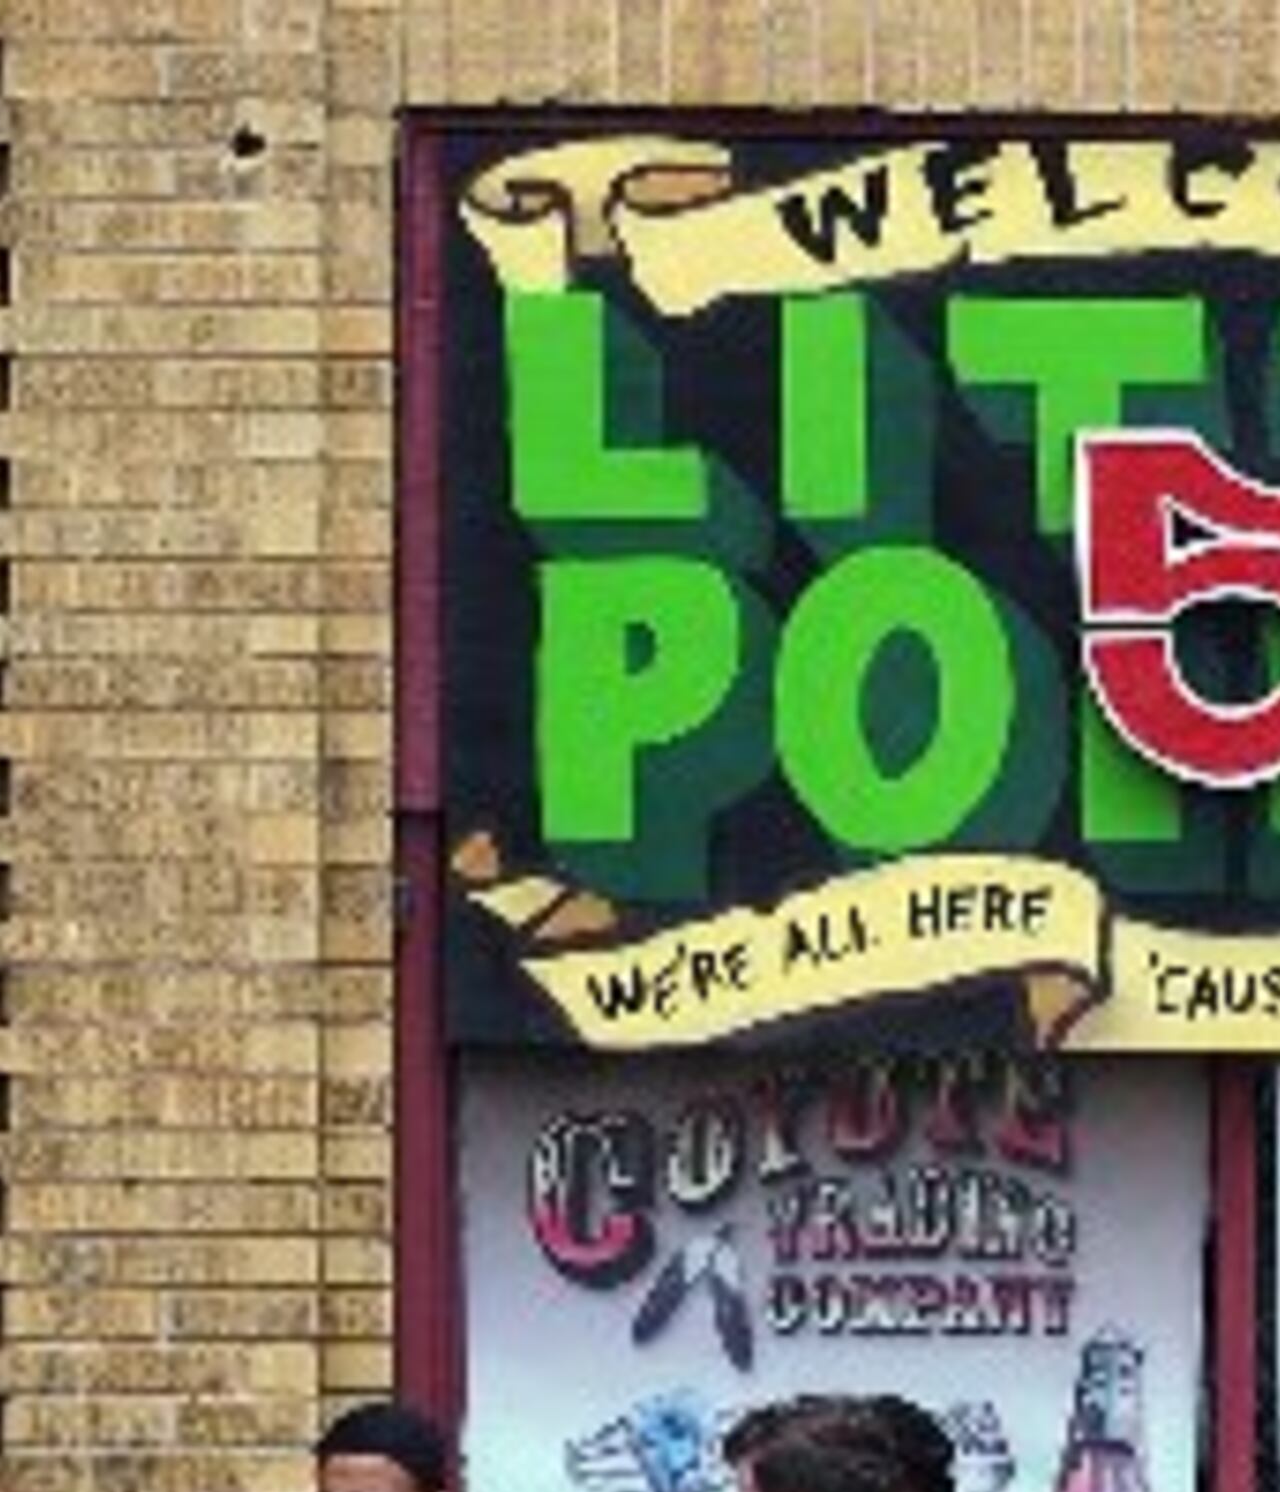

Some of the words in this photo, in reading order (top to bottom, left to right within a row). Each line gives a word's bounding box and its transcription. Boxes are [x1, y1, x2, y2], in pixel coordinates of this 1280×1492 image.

[586, 938, 751, 1020] WE'RE
[781, 904, 882, 972] ALL
[906, 884, 1054, 939] HERE
[528, 1045, 1076, 1292] COYOTE
[766, 1163, 1078, 1268] TRADING
[766, 1272, 1076, 1337] COMPANY
